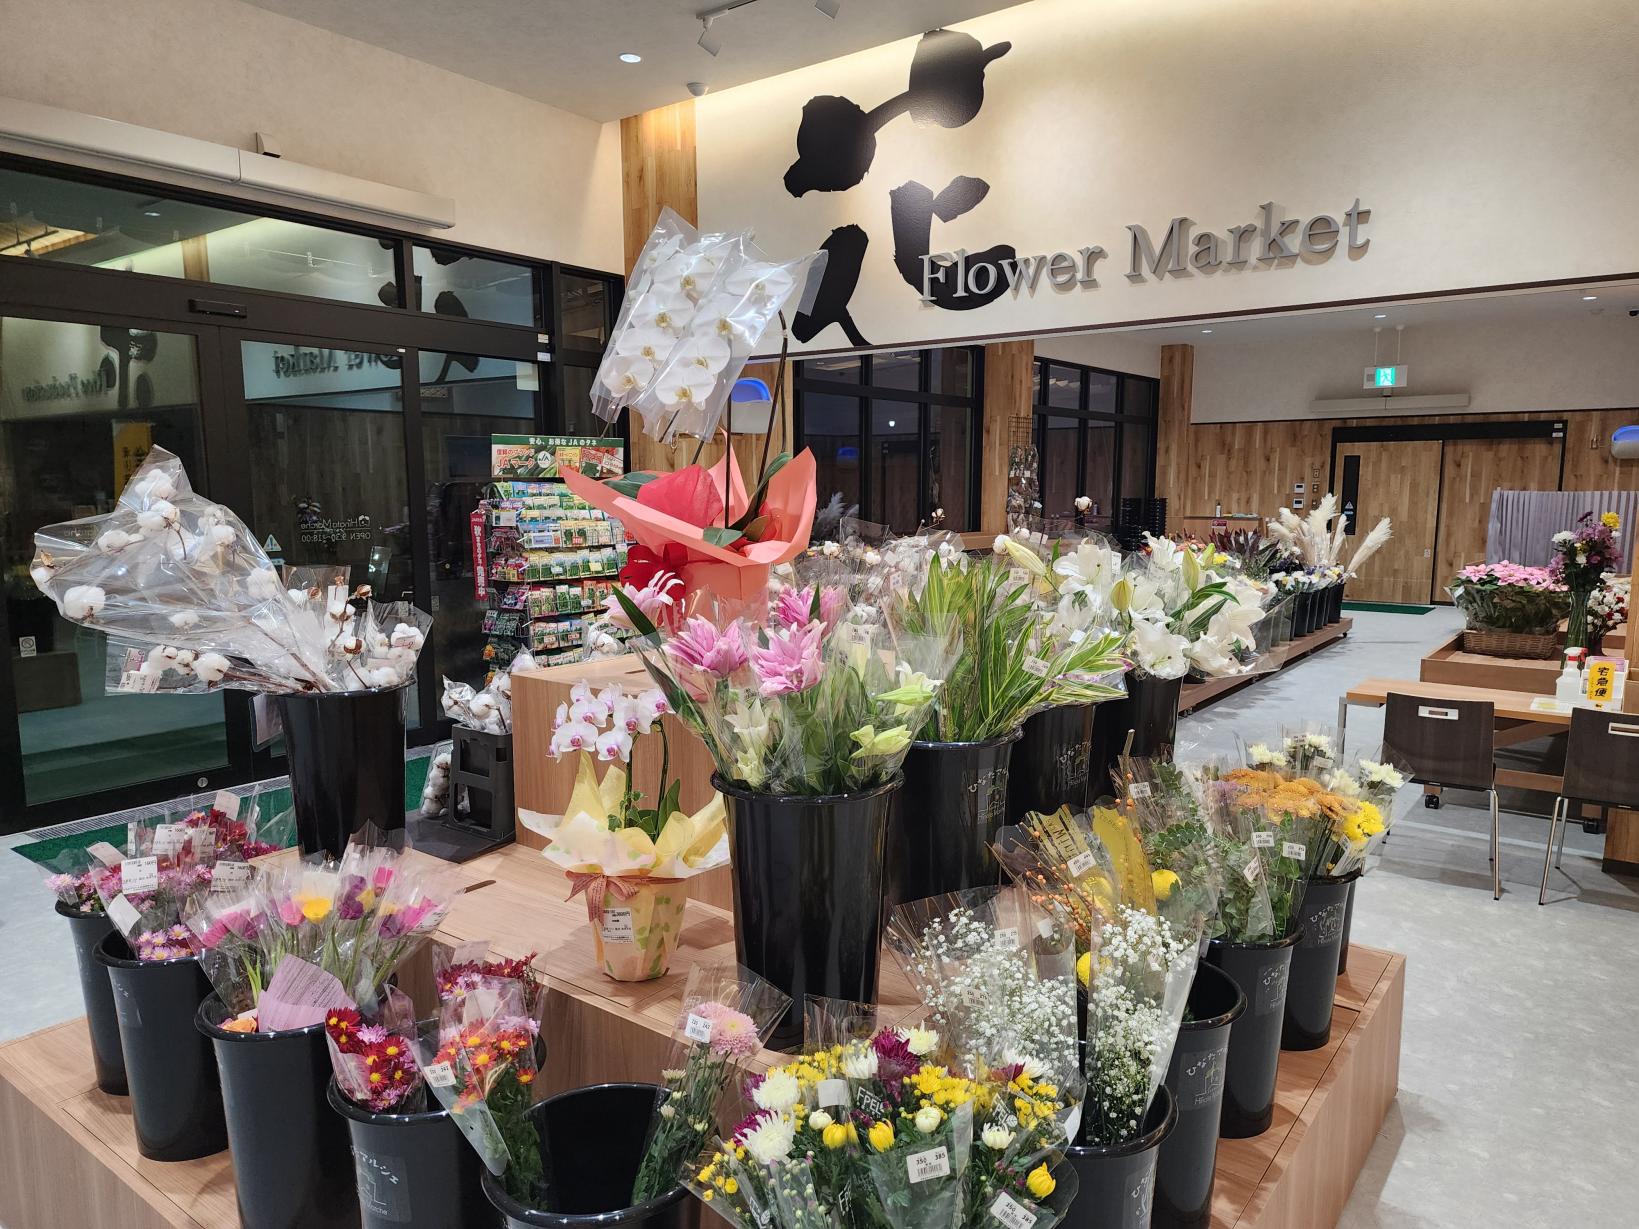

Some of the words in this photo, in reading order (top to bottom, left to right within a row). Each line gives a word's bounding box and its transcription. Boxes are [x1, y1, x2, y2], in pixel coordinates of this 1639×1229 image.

[918, 245, 1105, 305] Flower
[1125, 198, 1371, 282] Market
[1594, 666, 1610, 697] 宅急便
